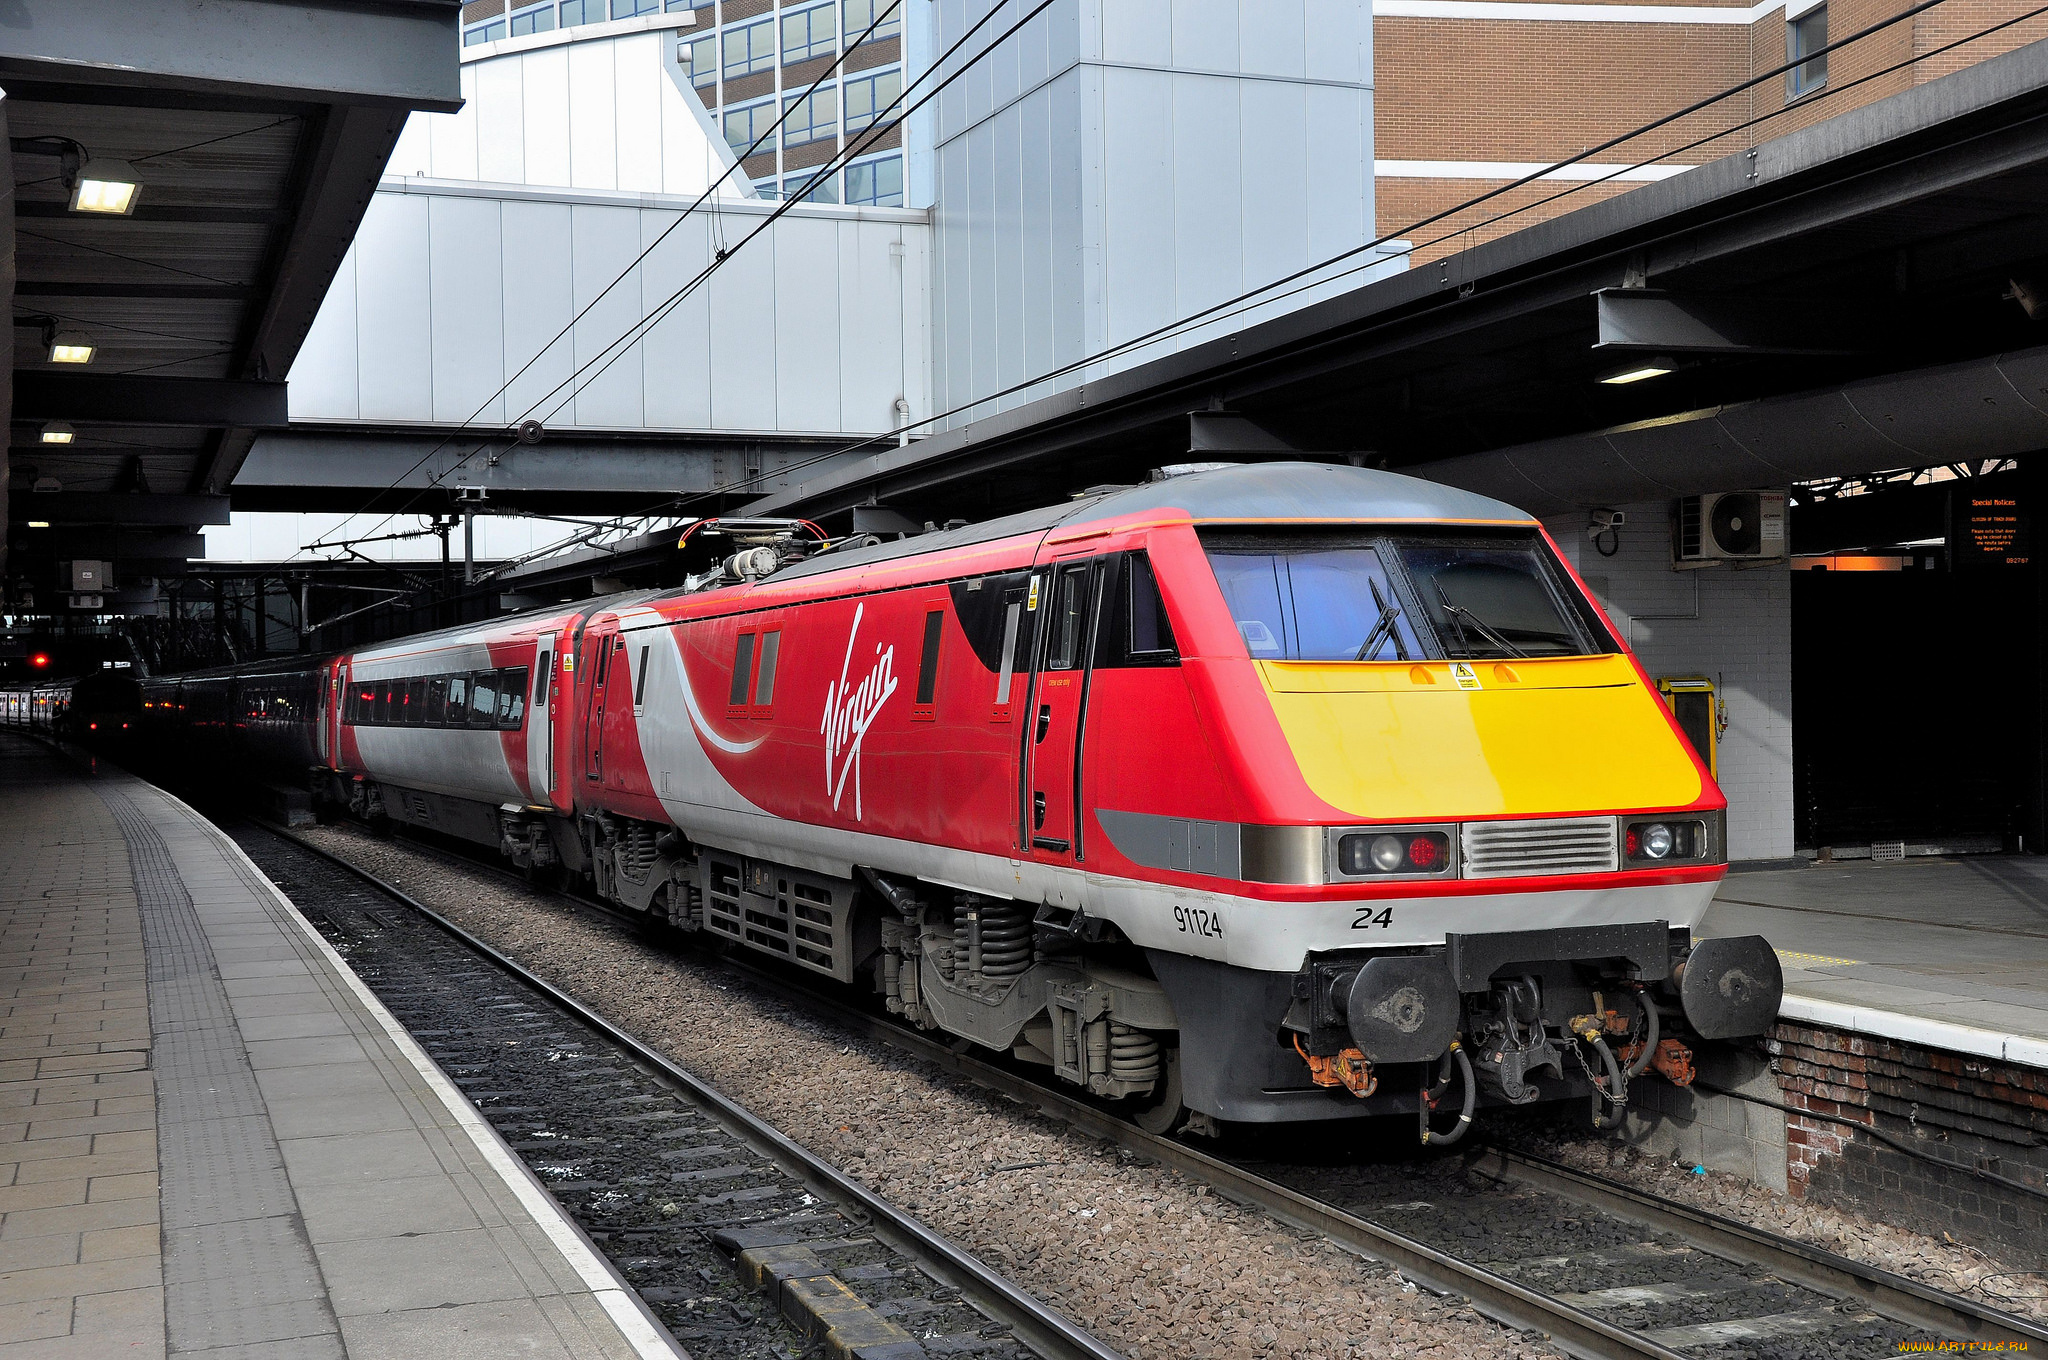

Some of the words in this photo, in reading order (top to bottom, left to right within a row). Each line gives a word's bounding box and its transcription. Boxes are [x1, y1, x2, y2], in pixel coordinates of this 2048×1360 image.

[820, 602, 898, 822] Virgin
[1173, 905, 1223, 939] 91124
[1351, 907, 1393, 930] 24
